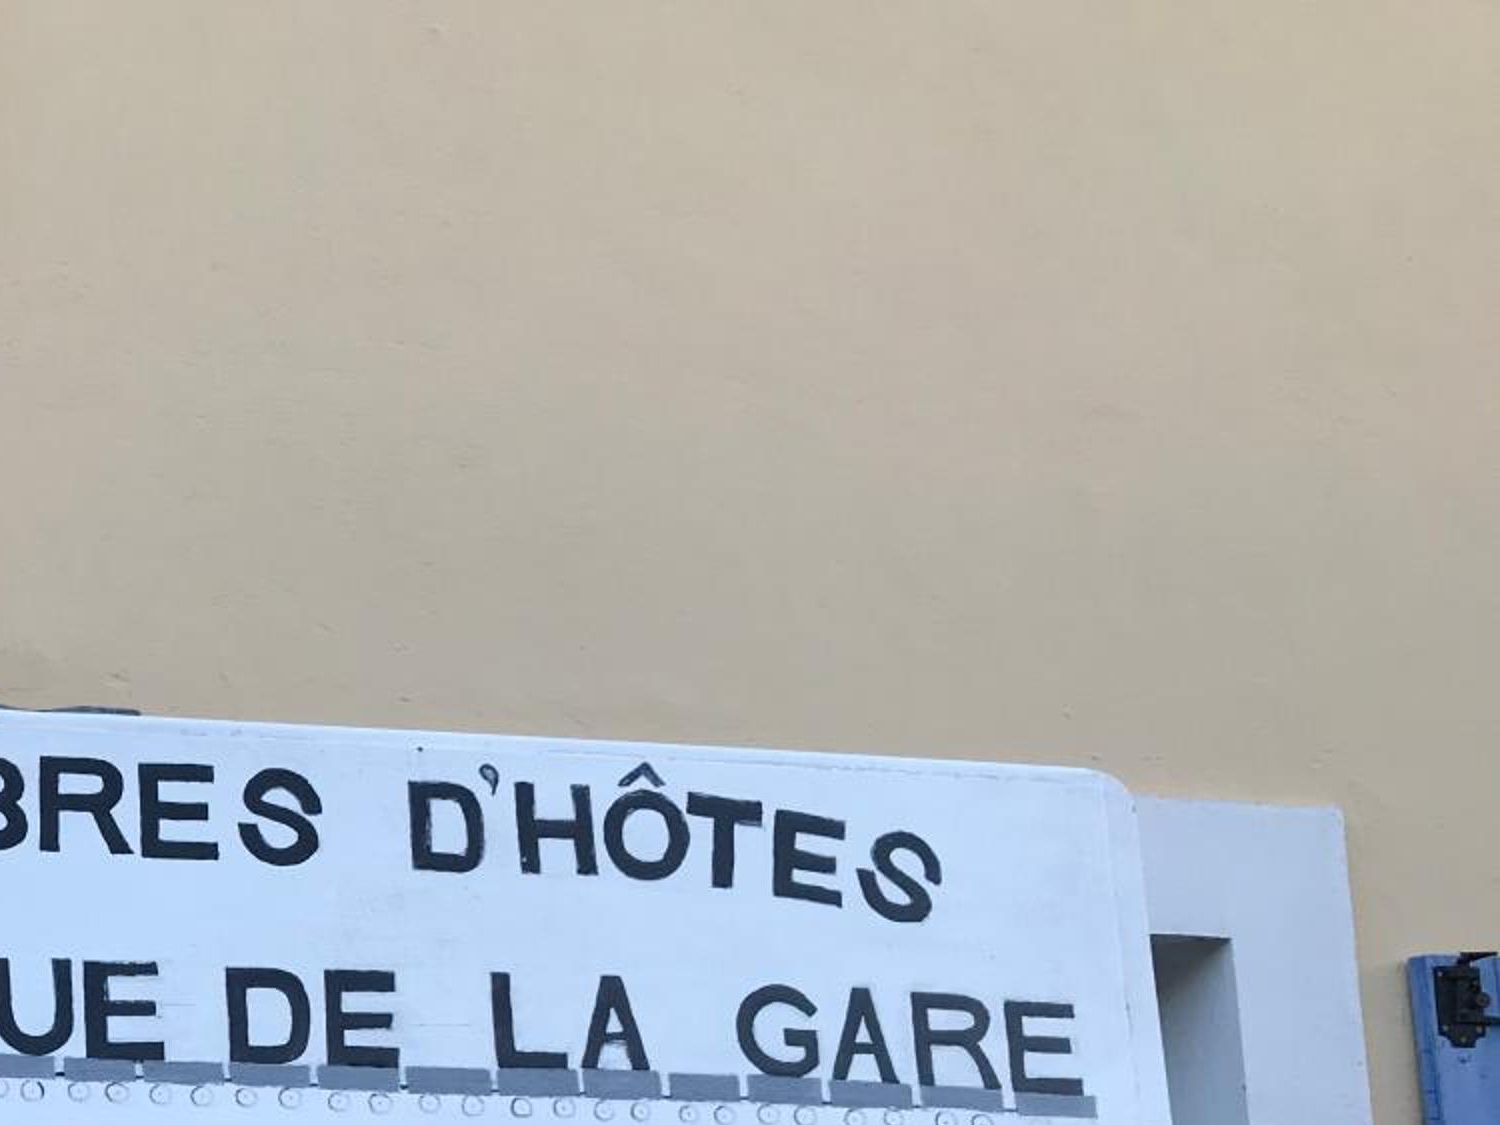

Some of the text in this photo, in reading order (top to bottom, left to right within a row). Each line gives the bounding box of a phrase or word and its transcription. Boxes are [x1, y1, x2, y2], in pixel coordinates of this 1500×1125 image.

[407, 762, 943, 923] D'HÔTES
[225, 967, 401, 1070] DE
[491, 972, 650, 1072] LA
[736, 984, 1084, 1097] GARE
